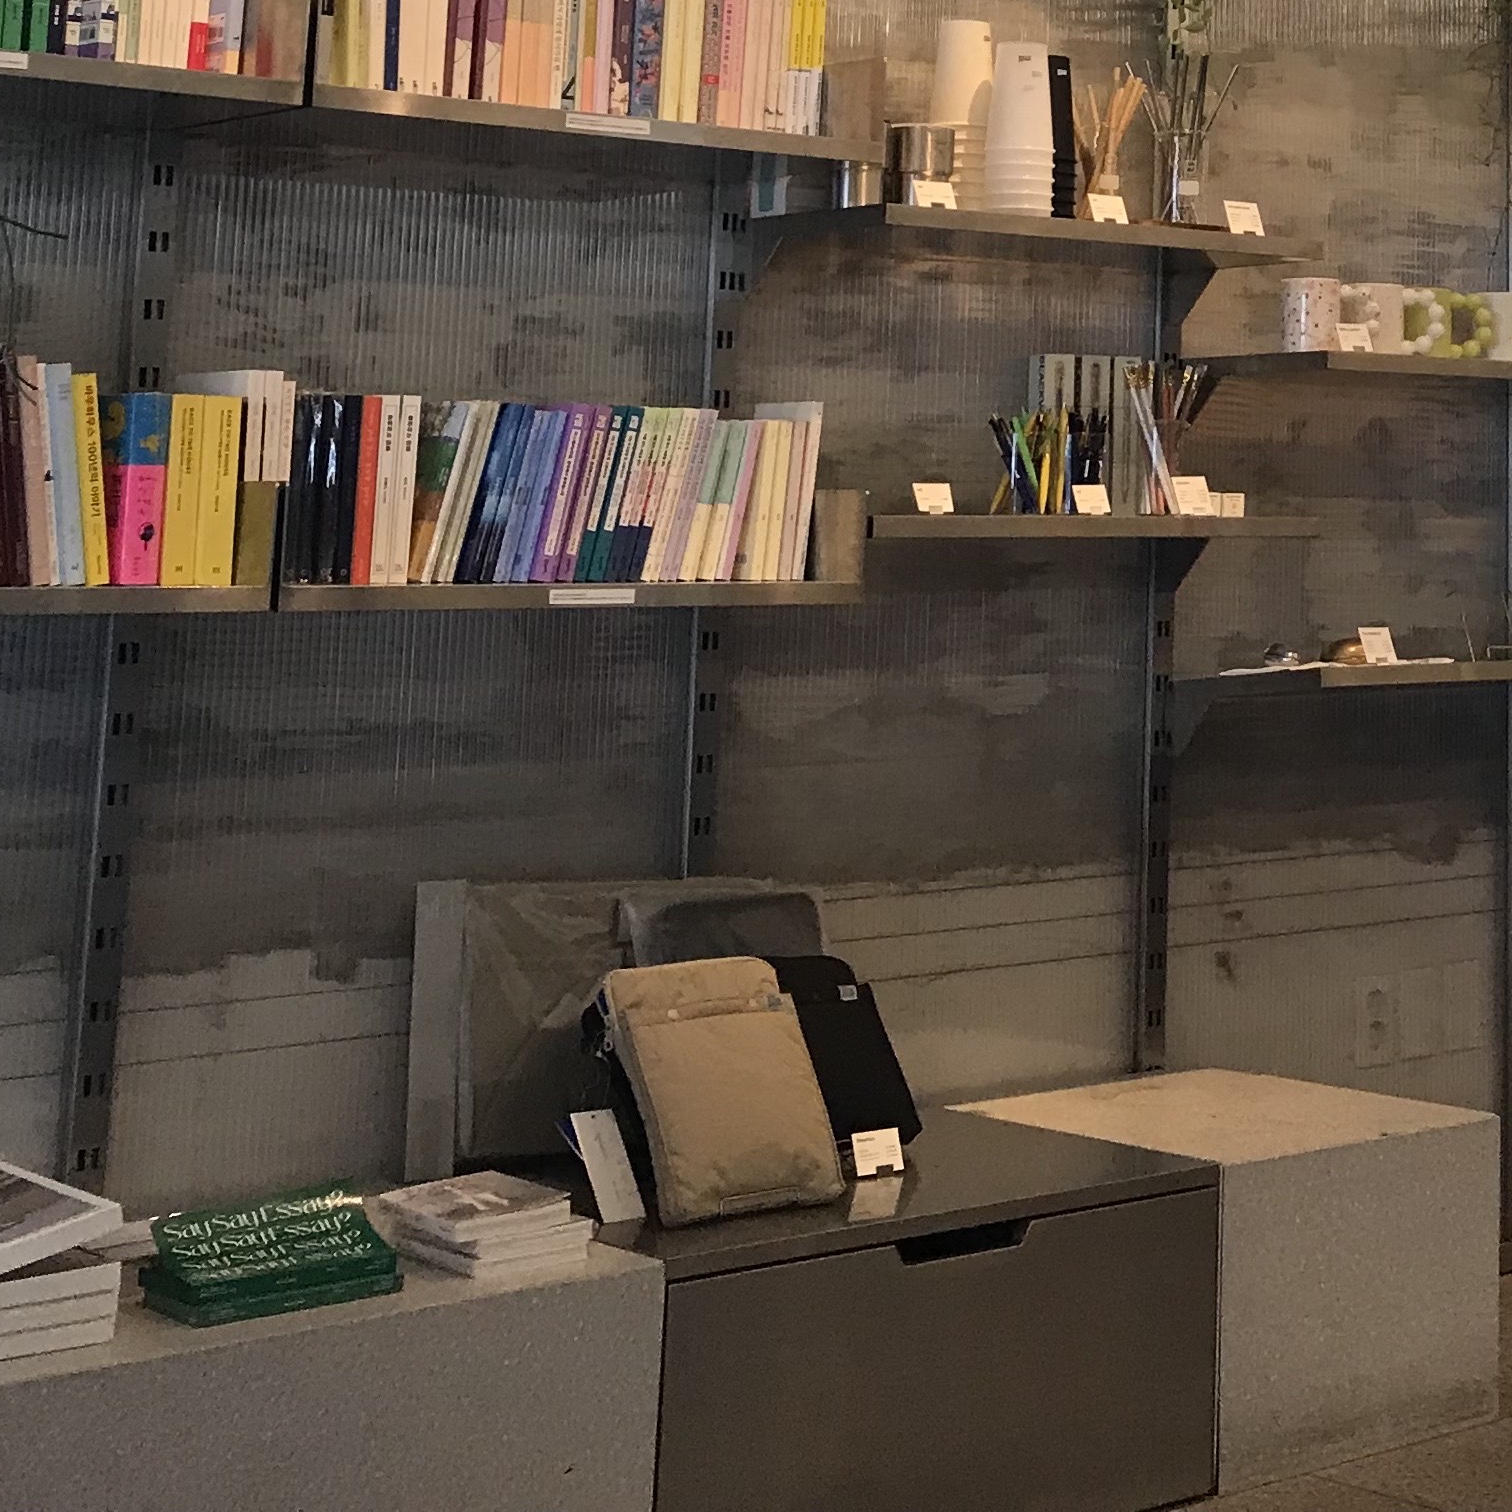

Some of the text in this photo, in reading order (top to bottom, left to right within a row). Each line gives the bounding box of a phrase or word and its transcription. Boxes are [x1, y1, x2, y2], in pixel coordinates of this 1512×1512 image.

[85, 385, 101, 517] 바우하우스 100년의 이야기
